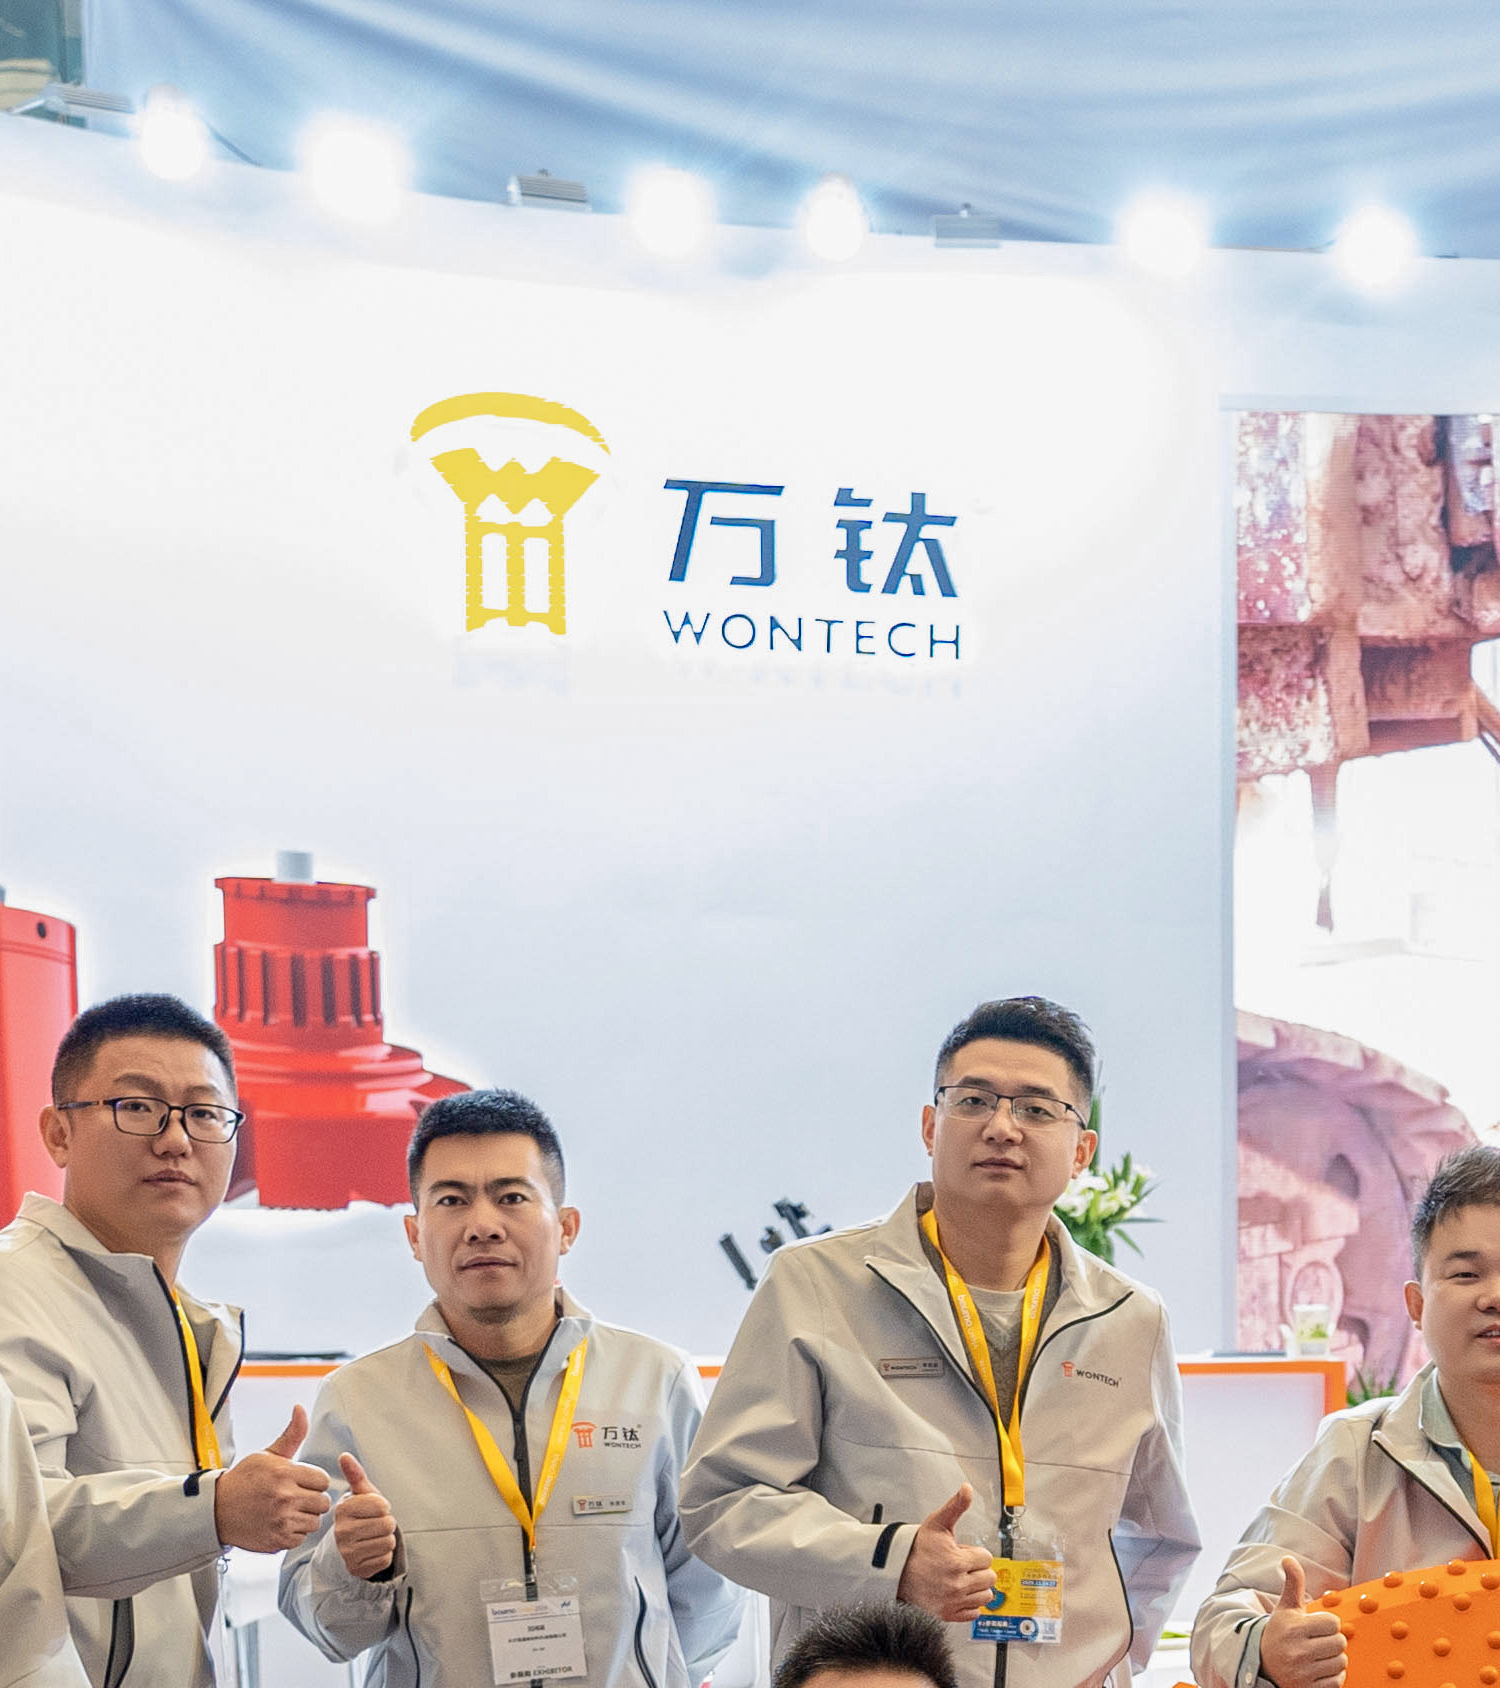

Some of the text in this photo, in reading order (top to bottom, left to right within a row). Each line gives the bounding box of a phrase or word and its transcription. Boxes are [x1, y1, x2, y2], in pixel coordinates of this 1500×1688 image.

[663, 478, 959, 598] 万钛
[663, 610, 961, 660] WONTECH
[1076, 1368, 1120, 1389] WONTECH
